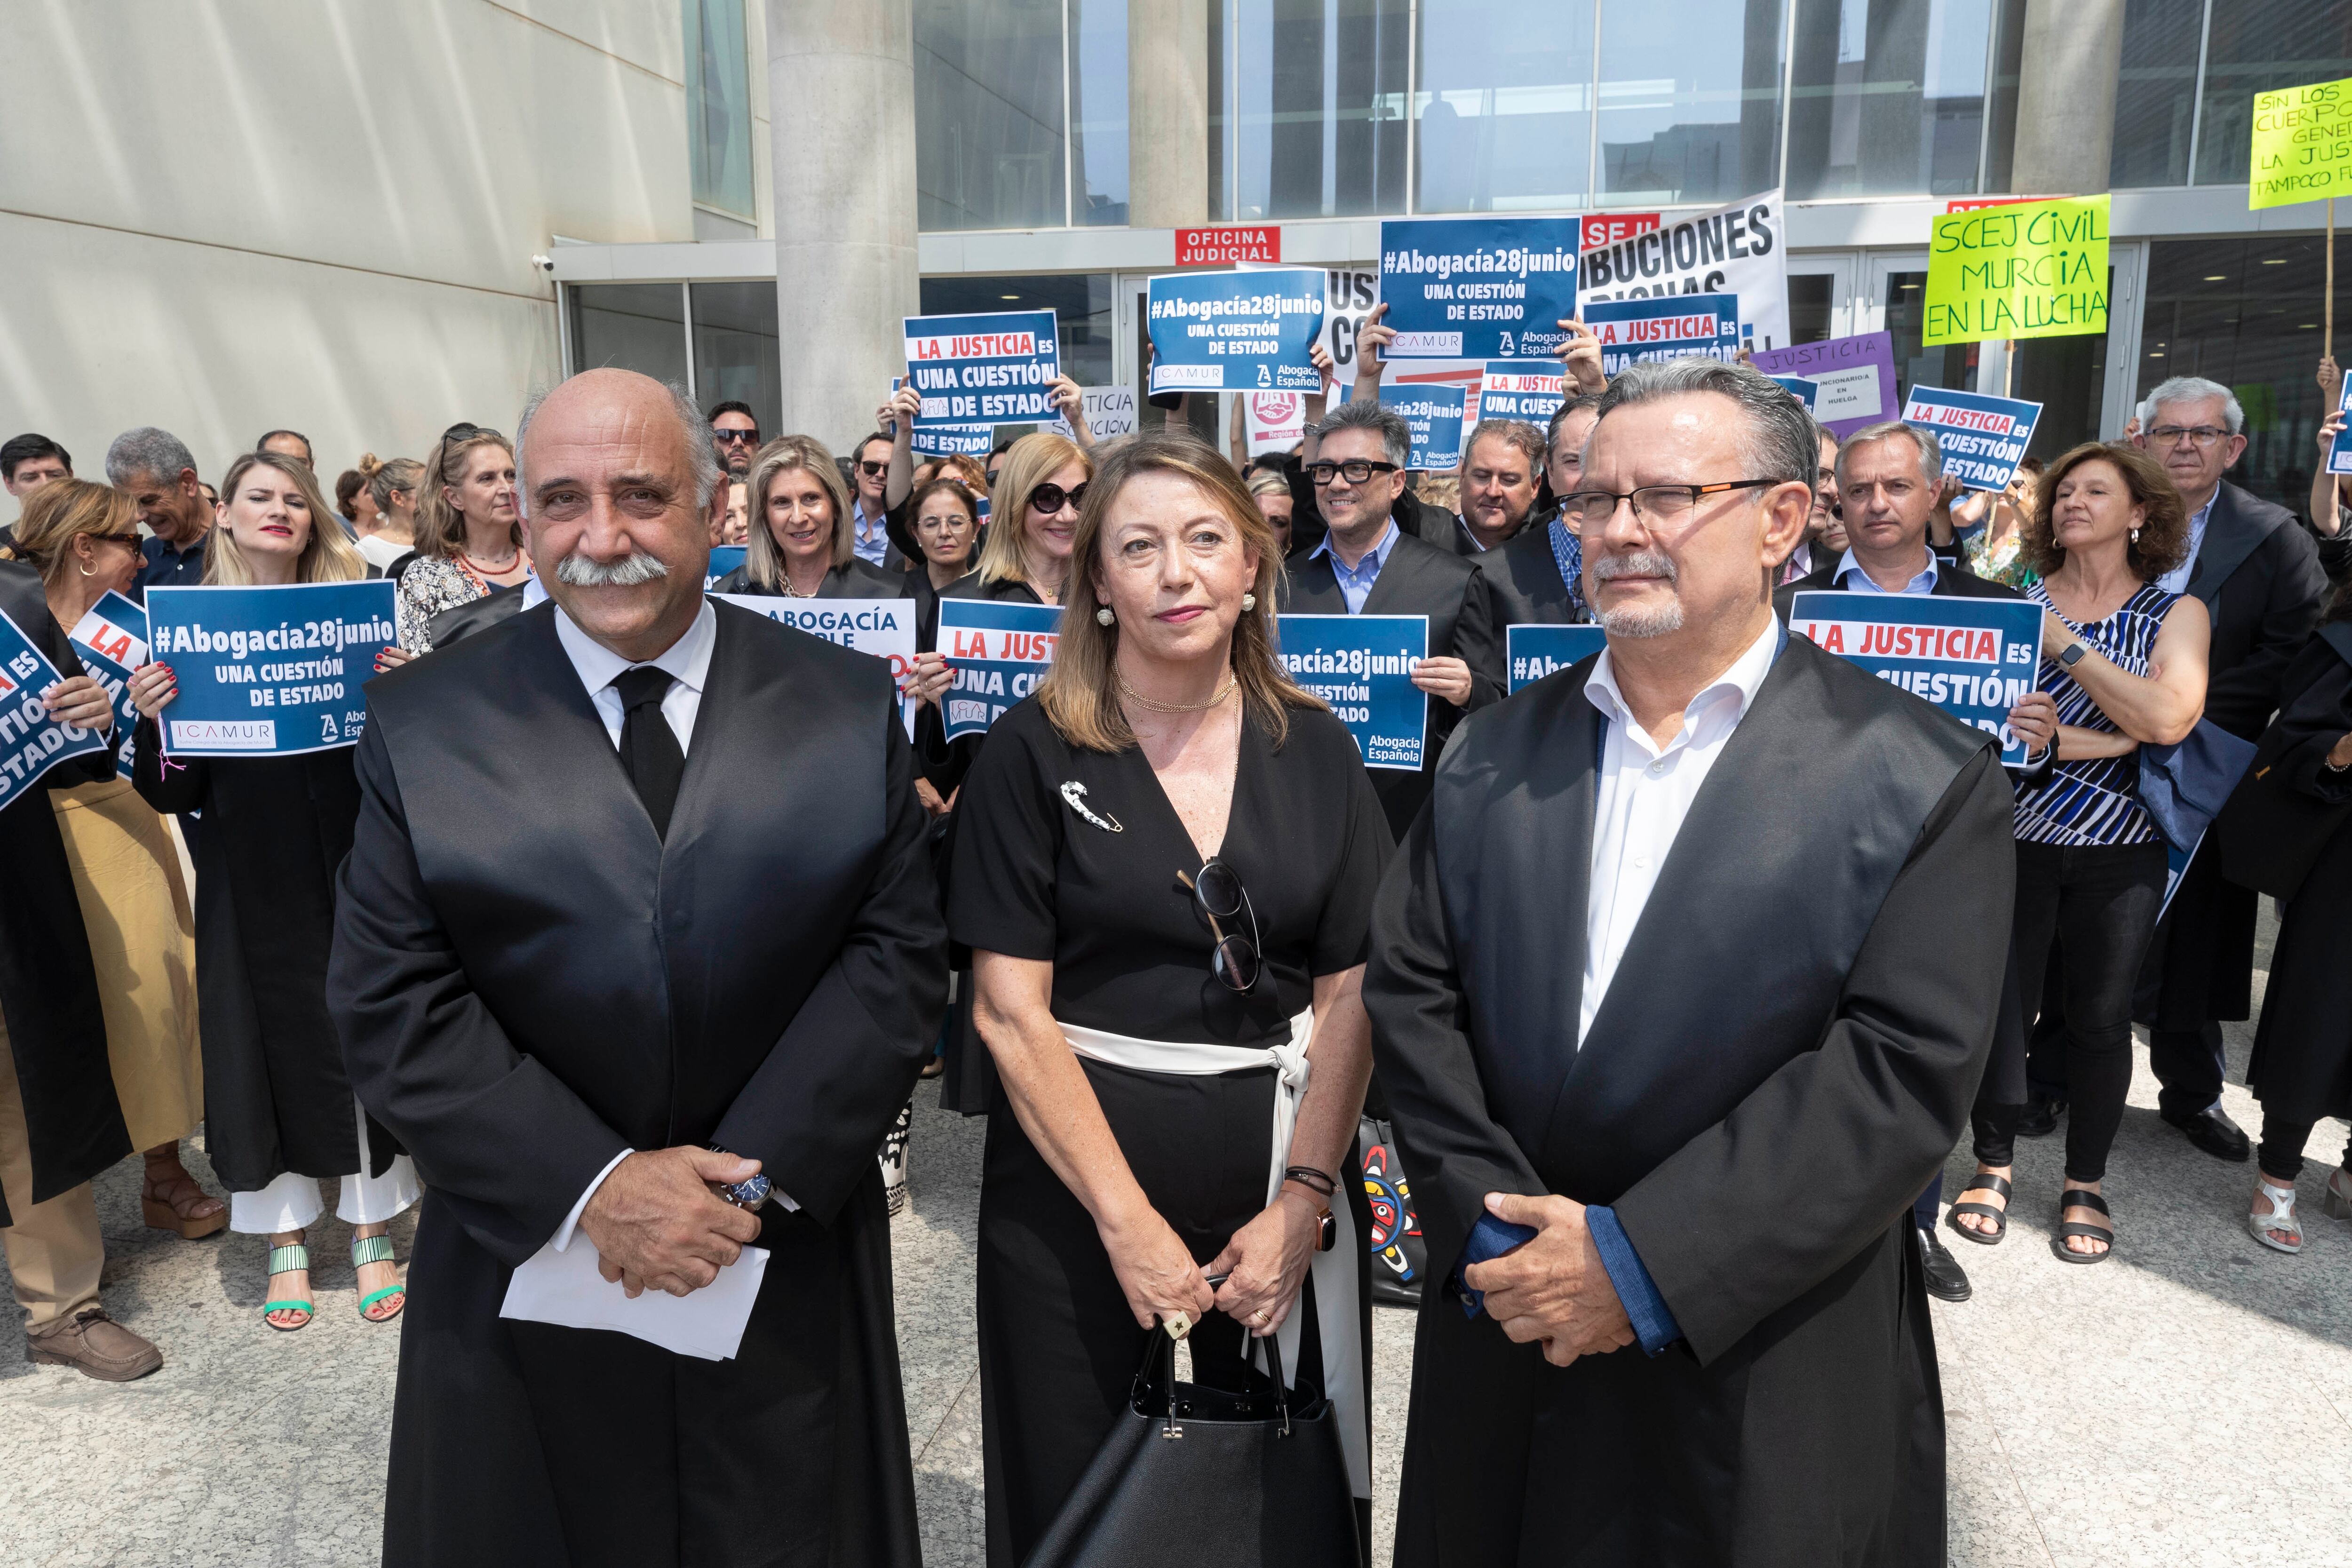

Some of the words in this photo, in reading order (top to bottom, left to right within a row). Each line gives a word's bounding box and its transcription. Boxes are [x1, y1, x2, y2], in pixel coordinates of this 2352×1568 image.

[2301, 84, 2340, 104] LOS
[2261, 153, 2283, 170] LA
[2255, 171, 2331, 196] TAMPOCO
[1187, 230, 1268, 246] OFICINA
[1581, 223, 1625, 246] SE
[1936, 213, 2024, 253] SCEJ
[1182, 247, 1272, 263] JUDICIAL
[1384, 247, 1575, 280] #Abogacía28junio
[1330, 271, 1379, 311] US
[1424, 284, 1454, 300] UNA
[1457, 279, 1526, 299] CUESTIÓN
[1151, 294, 1323, 321] #Abogacía28junio
[1447, 305, 1465, 320] DE
[1469, 304, 1524, 320] ESTADO
[1928, 301, 1969, 337] EN
[1981, 297, 2018, 332] LA
[2024, 290, 2107, 329] LUCHA
[1187, 323, 1215, 337] UNA
[1217, 320, 1279, 337] CUESTIÓN
[1522, 331, 1571, 344] Abogacía
[1593, 325, 1617, 345] LA
[1627, 316, 1715, 342] JUSTICIA
[1721, 321, 1735, 335] ES
[918, 339, 941, 359] LA
[951, 334, 1033, 357] JUSTICIA
[1038, 339, 1054, 354] ES
[1208, 341, 1226, 355] DE
[1229, 340, 1279, 355] ESTADO
[1770, 340, 1876, 369] JUSTICIA
[916, 367, 959, 390] UNA
[962, 358, 1055, 388] CUESTIÓN
[1157, 368, 1219, 379] ICAMUR
[1277, 365, 1319, 376] Abogacía
[1277, 376, 1319, 388] Española
[1491, 376, 1508, 390] LA
[952, 396, 977, 417] DE
[982, 393, 1055, 415] ESTADO
[1081, 394, 1133, 413] TICIA
[1486, 396, 1517, 413] UNA
[1828, 395, 1857, 405] HUELGA
[1913, 405, 1933, 422] LA
[1939, 408, 2010, 433] JUSTICIA
[2012, 424, 2030, 438] ES
[918, 434, 935, 450] DE
[939, 437, 989, 452] ESTADO
[1269, 430, 1293, 438] Región
[1426, 452, 1458, 460] Abogacía
[1939, 432, 2022, 462] CUESTIÓN
[1425, 458, 1457, 467] Española
[1943, 456, 2010, 485] ESTADO
[89, 623, 132, 663] LA
[156, 615, 394, 660] #Abogacía28junio
[954, 631, 987, 659] LA
[1859, 625, 1996, 661] JUSTICIA
[2006, 643, 2032, 664] ES
[8, 650, 40, 680] ES
[215, 665, 257, 683] UNA
[261, 655, 344, 681] CUESTIÓN
[950, 669, 1005, 696] UNA
[250, 689, 275, 707] DE
[280, 682, 344, 706] ESTADO
[178, 725, 270, 738] ICAMUR
[1369, 735, 1420, 749] Abogacía
[1368, 748, 1419, 762] Española
